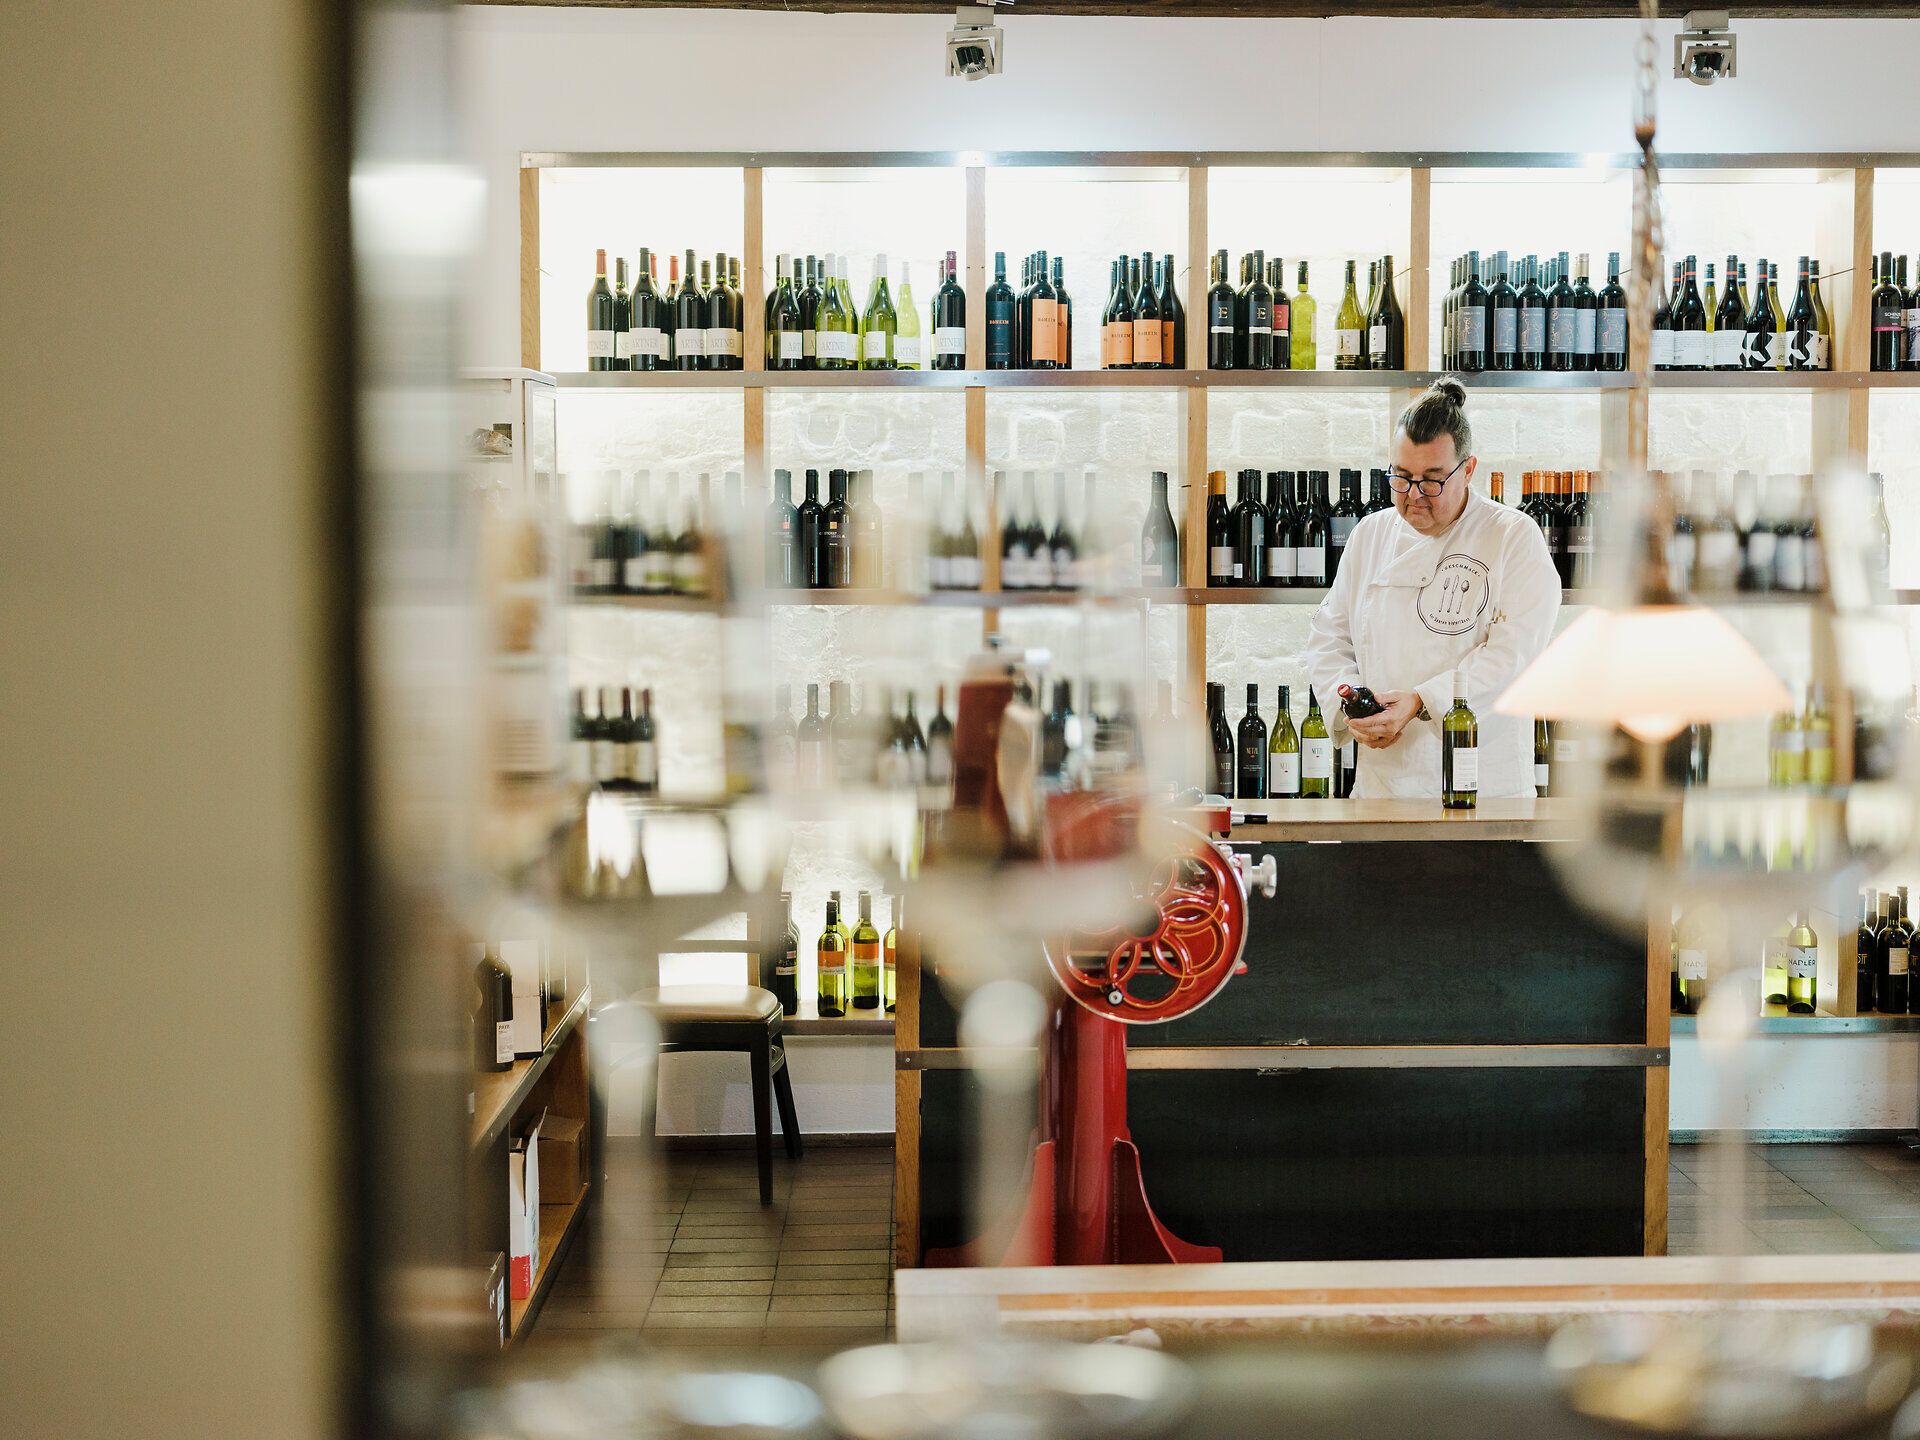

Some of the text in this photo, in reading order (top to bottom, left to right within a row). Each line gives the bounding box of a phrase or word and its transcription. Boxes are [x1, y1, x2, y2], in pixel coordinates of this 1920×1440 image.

[1218, 306, 1228, 319] E
[1256, 307, 1266, 320] E
[1788, 957, 1817, 967] NADLER
